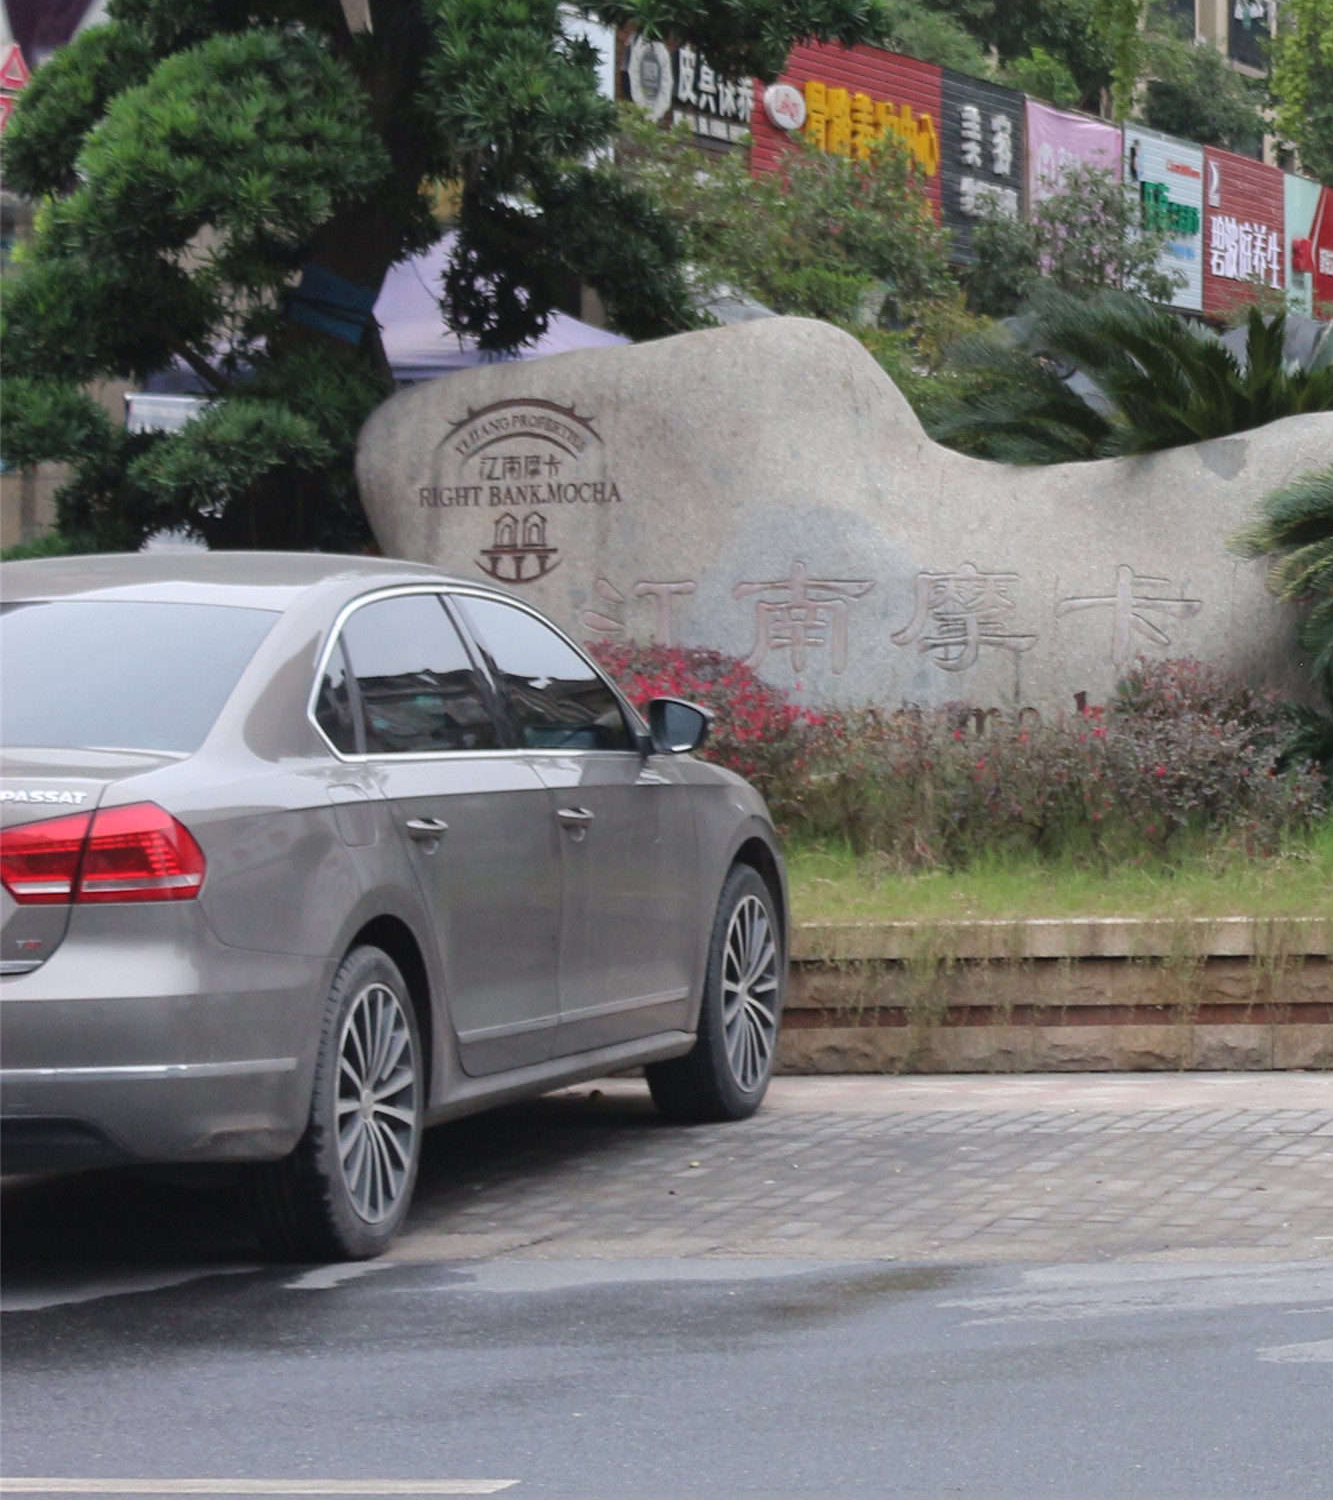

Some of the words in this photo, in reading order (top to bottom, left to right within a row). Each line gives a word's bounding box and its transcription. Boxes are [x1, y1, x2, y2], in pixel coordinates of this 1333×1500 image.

[479, 453, 562, 481] 江南摩卡
[419, 486, 483, 508] RIGHT
[582, 562, 1203, 675] 江南摩卡
[0, 789, 87, 804] PASSAT
